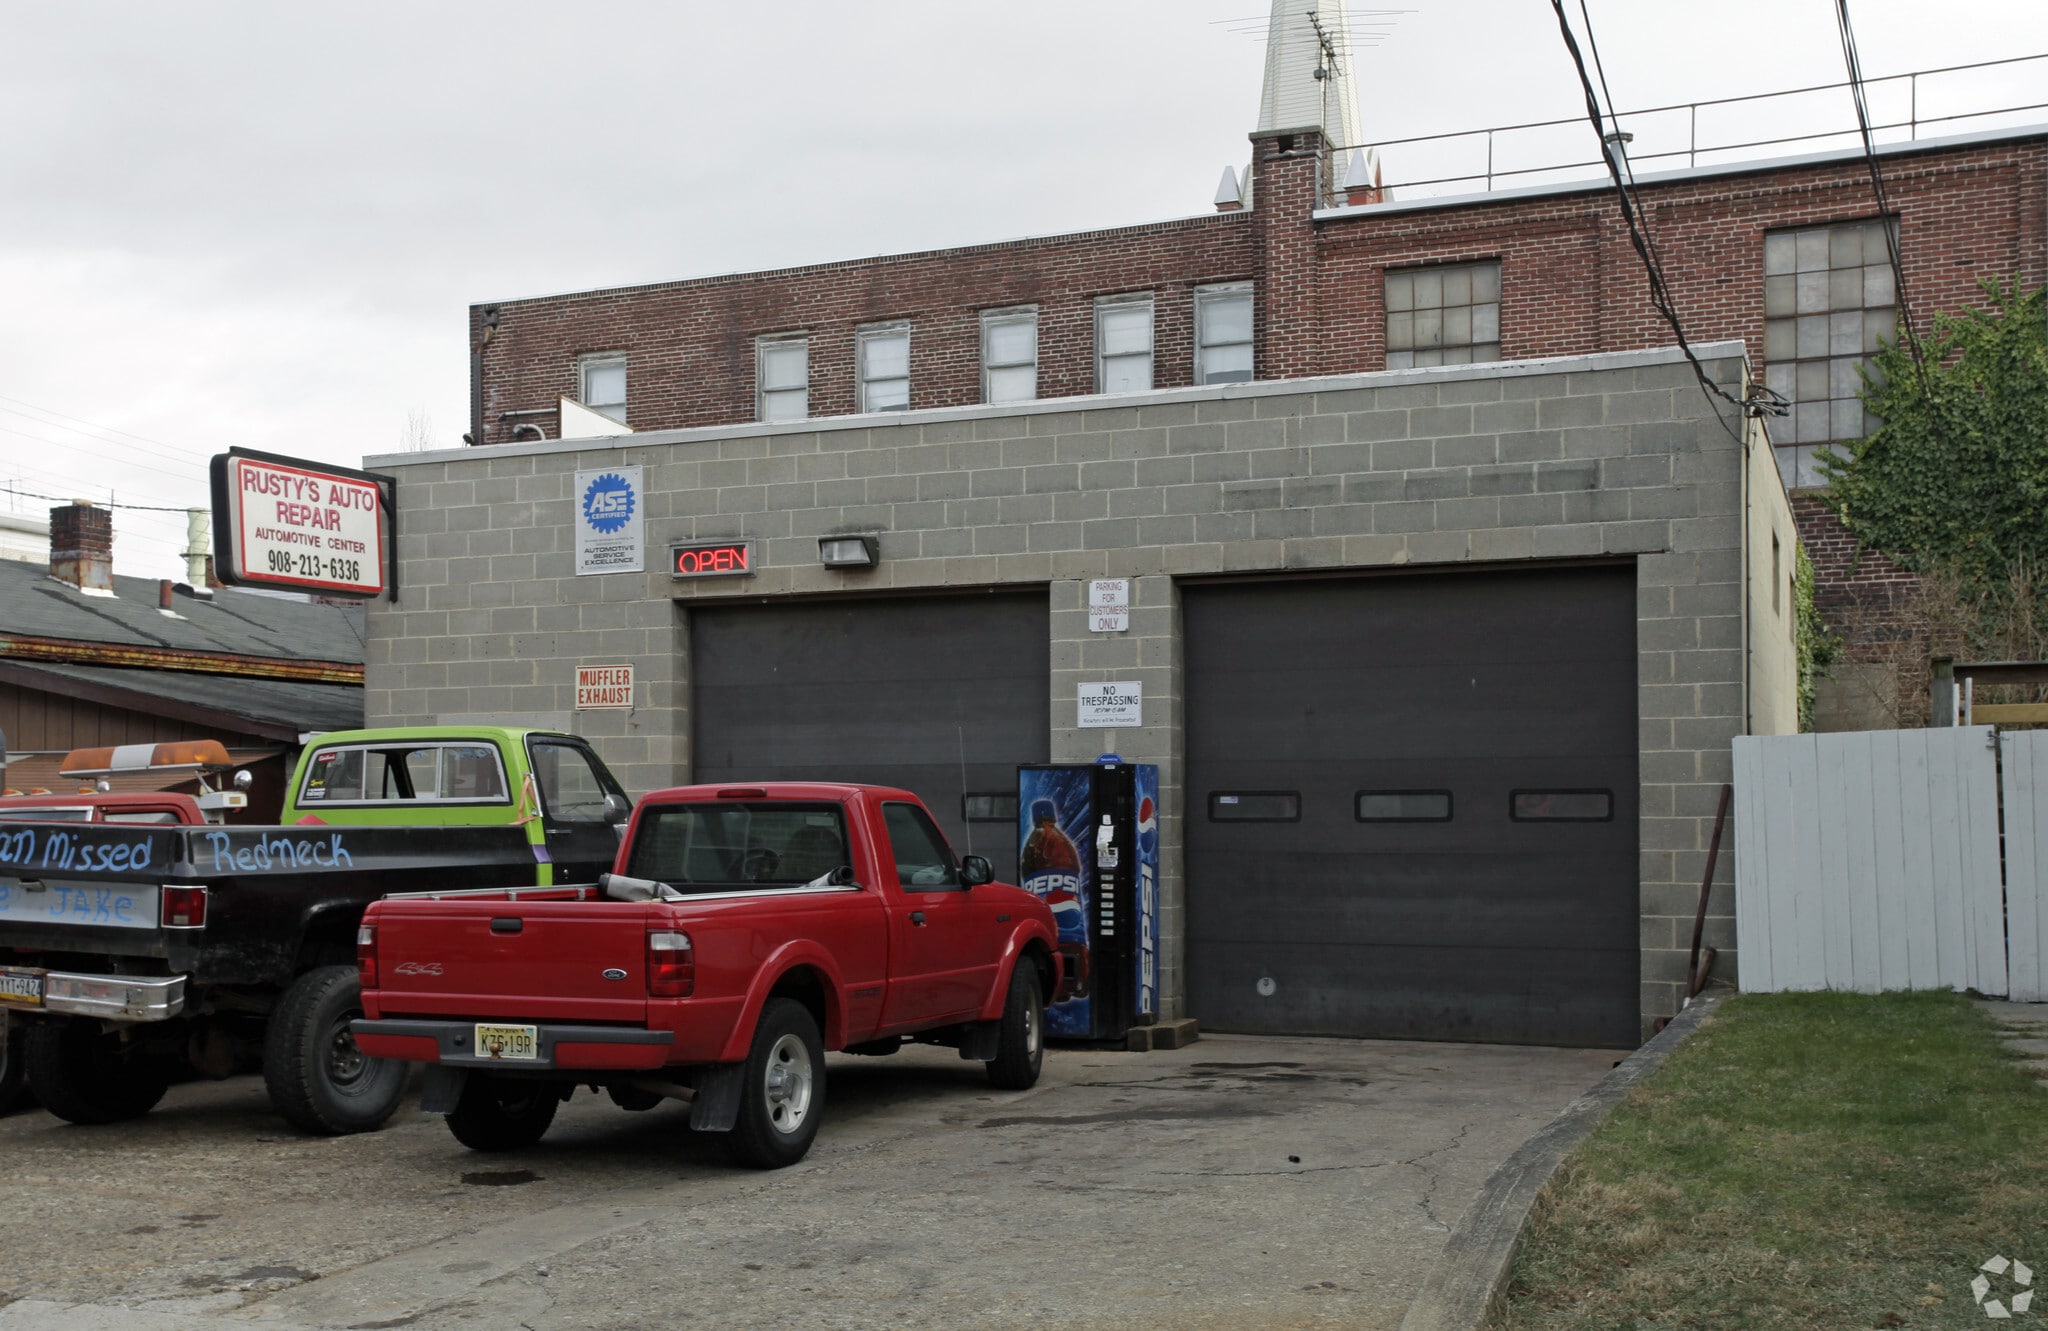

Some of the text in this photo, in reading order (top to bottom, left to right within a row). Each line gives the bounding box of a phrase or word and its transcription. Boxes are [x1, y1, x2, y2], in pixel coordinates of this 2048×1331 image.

[243, 468, 375, 512] RUSTY'S AUTO
[588, 490, 628, 513] ASE
[276, 500, 342, 532] REPAIR
[591, 511, 627, 520] CERTIFIED
[255, 527, 366, 554] AUTOMOTIVE CENTER
[584, 545, 635, 553] AUTOMOTIVE
[584, 557, 634, 566] EXCELLENCE
[593, 551, 626, 559] SERVICE
[679, 547, 748, 574] OPEN
[268, 549, 360, 582] 908-213-6336
[1095, 581, 1122, 591] PARKING
[1102, 593, 1115, 603] FOR
[1090, 604, 1128, 616] CUSTOMERS
[1098, 617, 1118, 630] ONLY
[579, 669, 630, 686] MUFFLER
[578, 687, 631, 704] EXHAUST
[1102, 685, 1116, 696] NO
[1081, 695, 1139, 706] TRESPASSING
[42, 832, 153, 872] Missed
[205, 831, 353, 872] Redneck
[1024, 874, 1079, 895] PEPSI
[1141, 862, 1153, 1014] PEPSI
